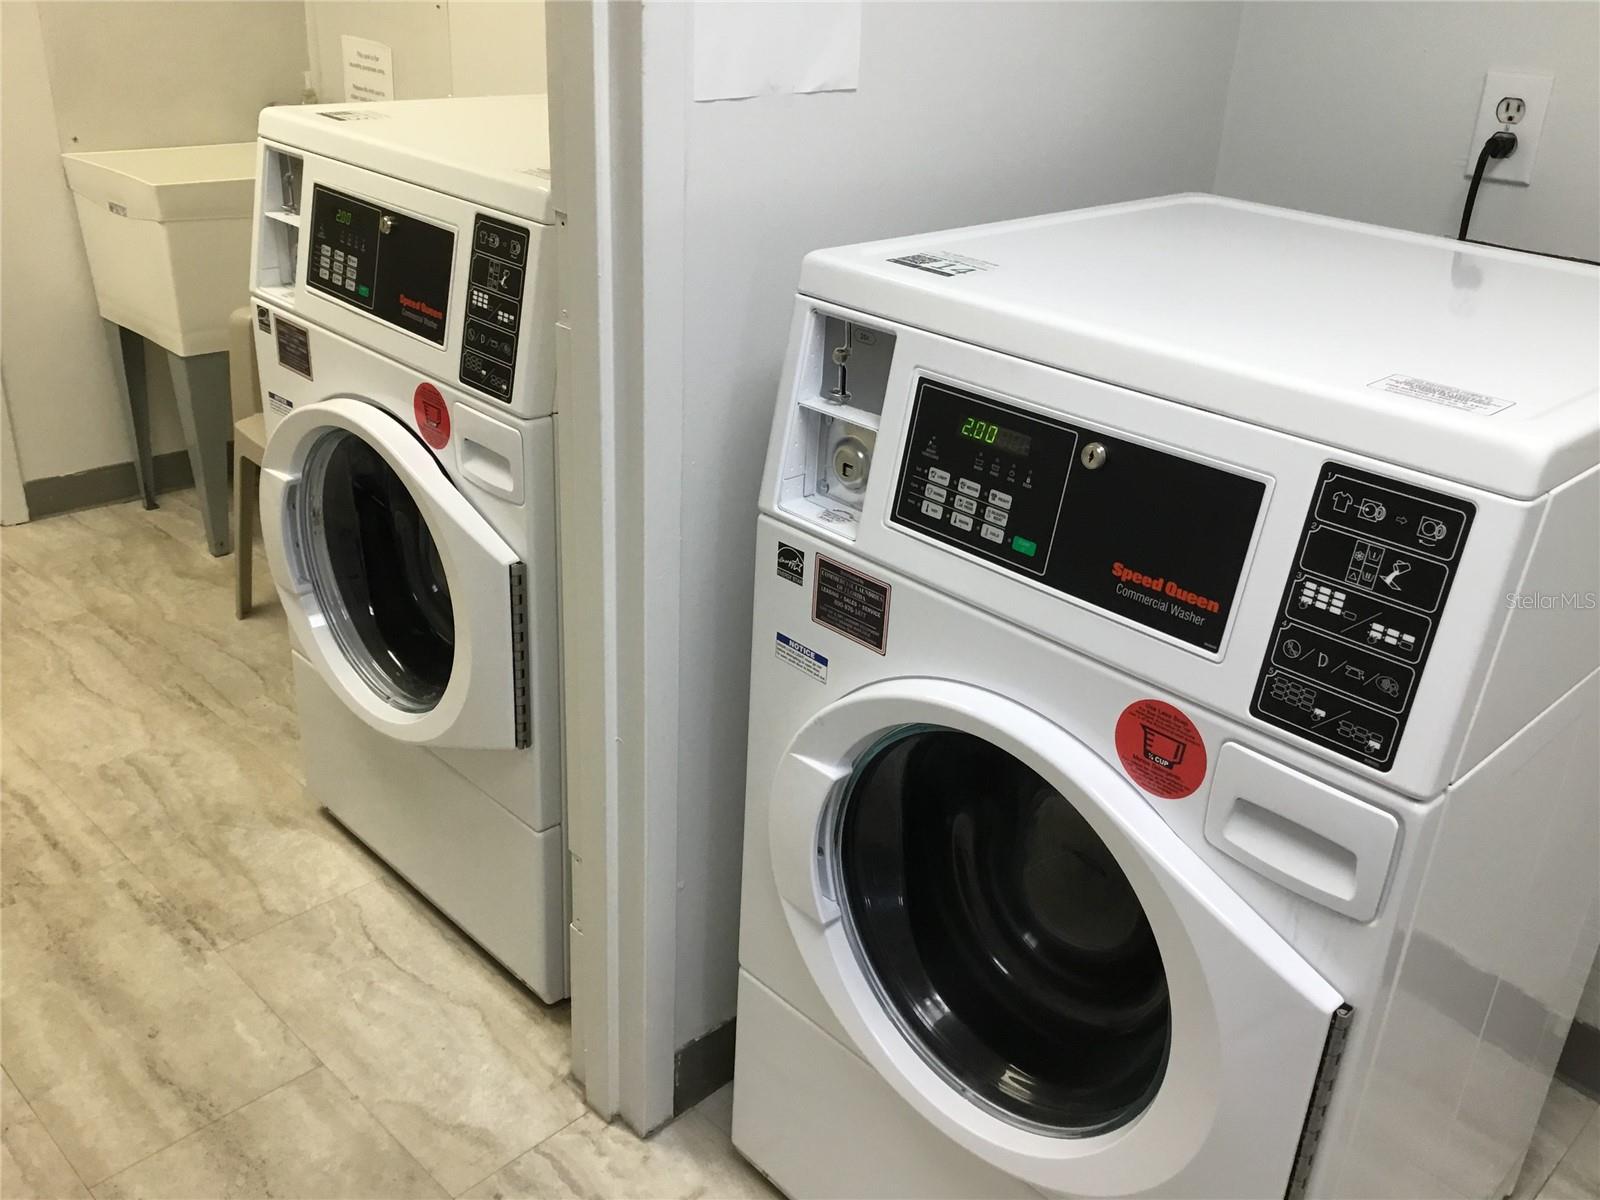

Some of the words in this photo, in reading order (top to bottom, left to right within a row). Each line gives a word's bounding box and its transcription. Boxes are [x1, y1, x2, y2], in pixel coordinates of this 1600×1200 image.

[961, 417, 998, 443] 2.00
[1311, 522, 1318, 530] 2
[1295, 571, 1302, 579] 3
[1111, 561, 1164, 592] Speed
[1165, 581, 1219, 613] Queen
[1115, 583, 1169, 612] Commercial
[1170, 603, 1206, 626] Washer
[1281, 619, 1288, 627] 4
[789, 640, 815, 660] NOTICE
[1154, 755, 1169, 766] CUP
